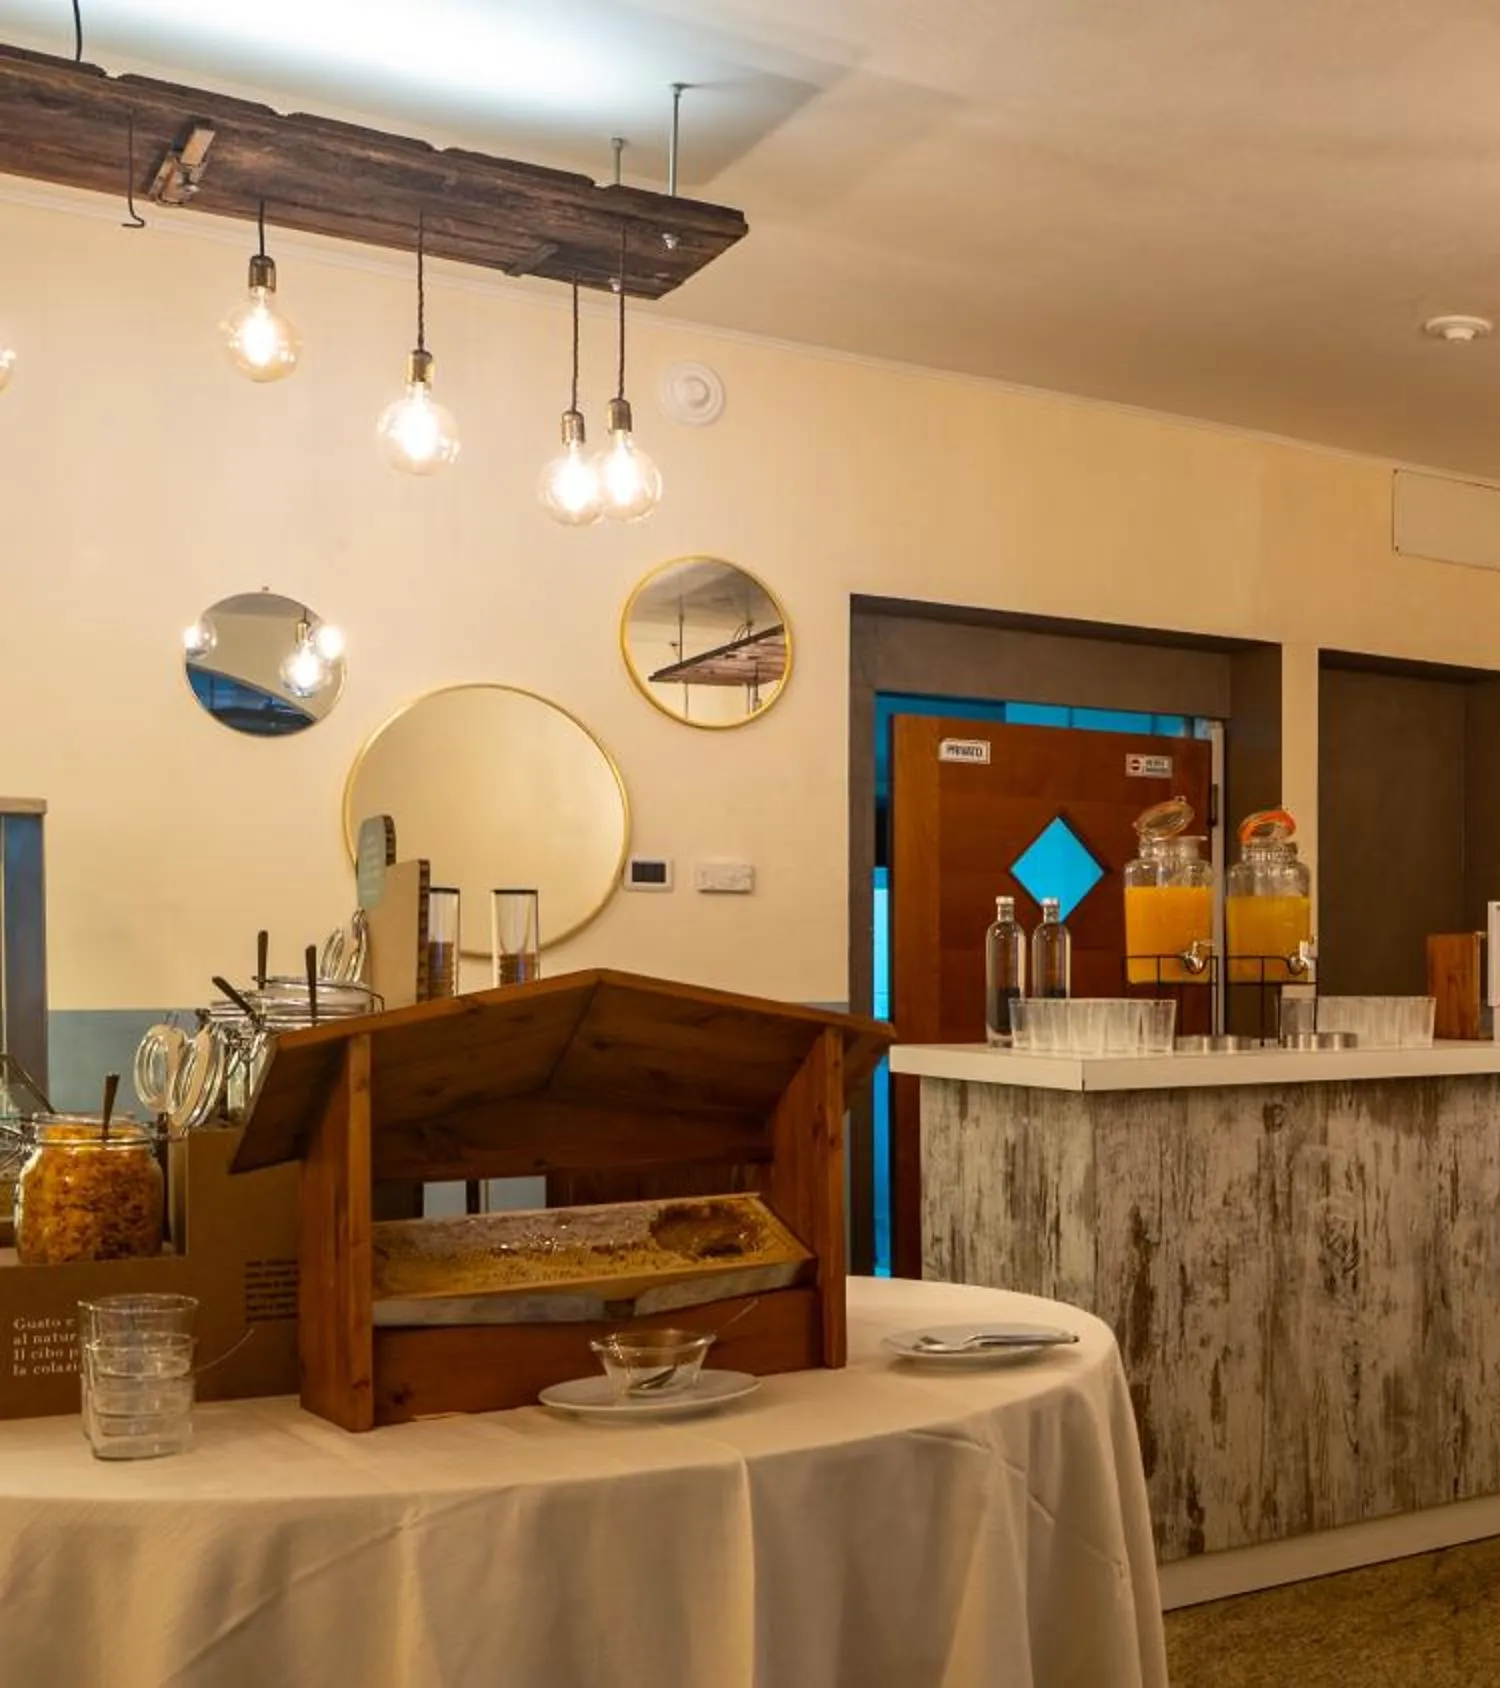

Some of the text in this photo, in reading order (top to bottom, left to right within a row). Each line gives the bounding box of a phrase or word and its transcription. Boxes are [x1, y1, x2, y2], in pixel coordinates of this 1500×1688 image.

[13, 1316, 62, 1331] Gusto
[13, 1332, 78, 1346] al natur
[30, 1345, 65, 1360] cibo
[13, 1361, 78, 1377] la colazi
